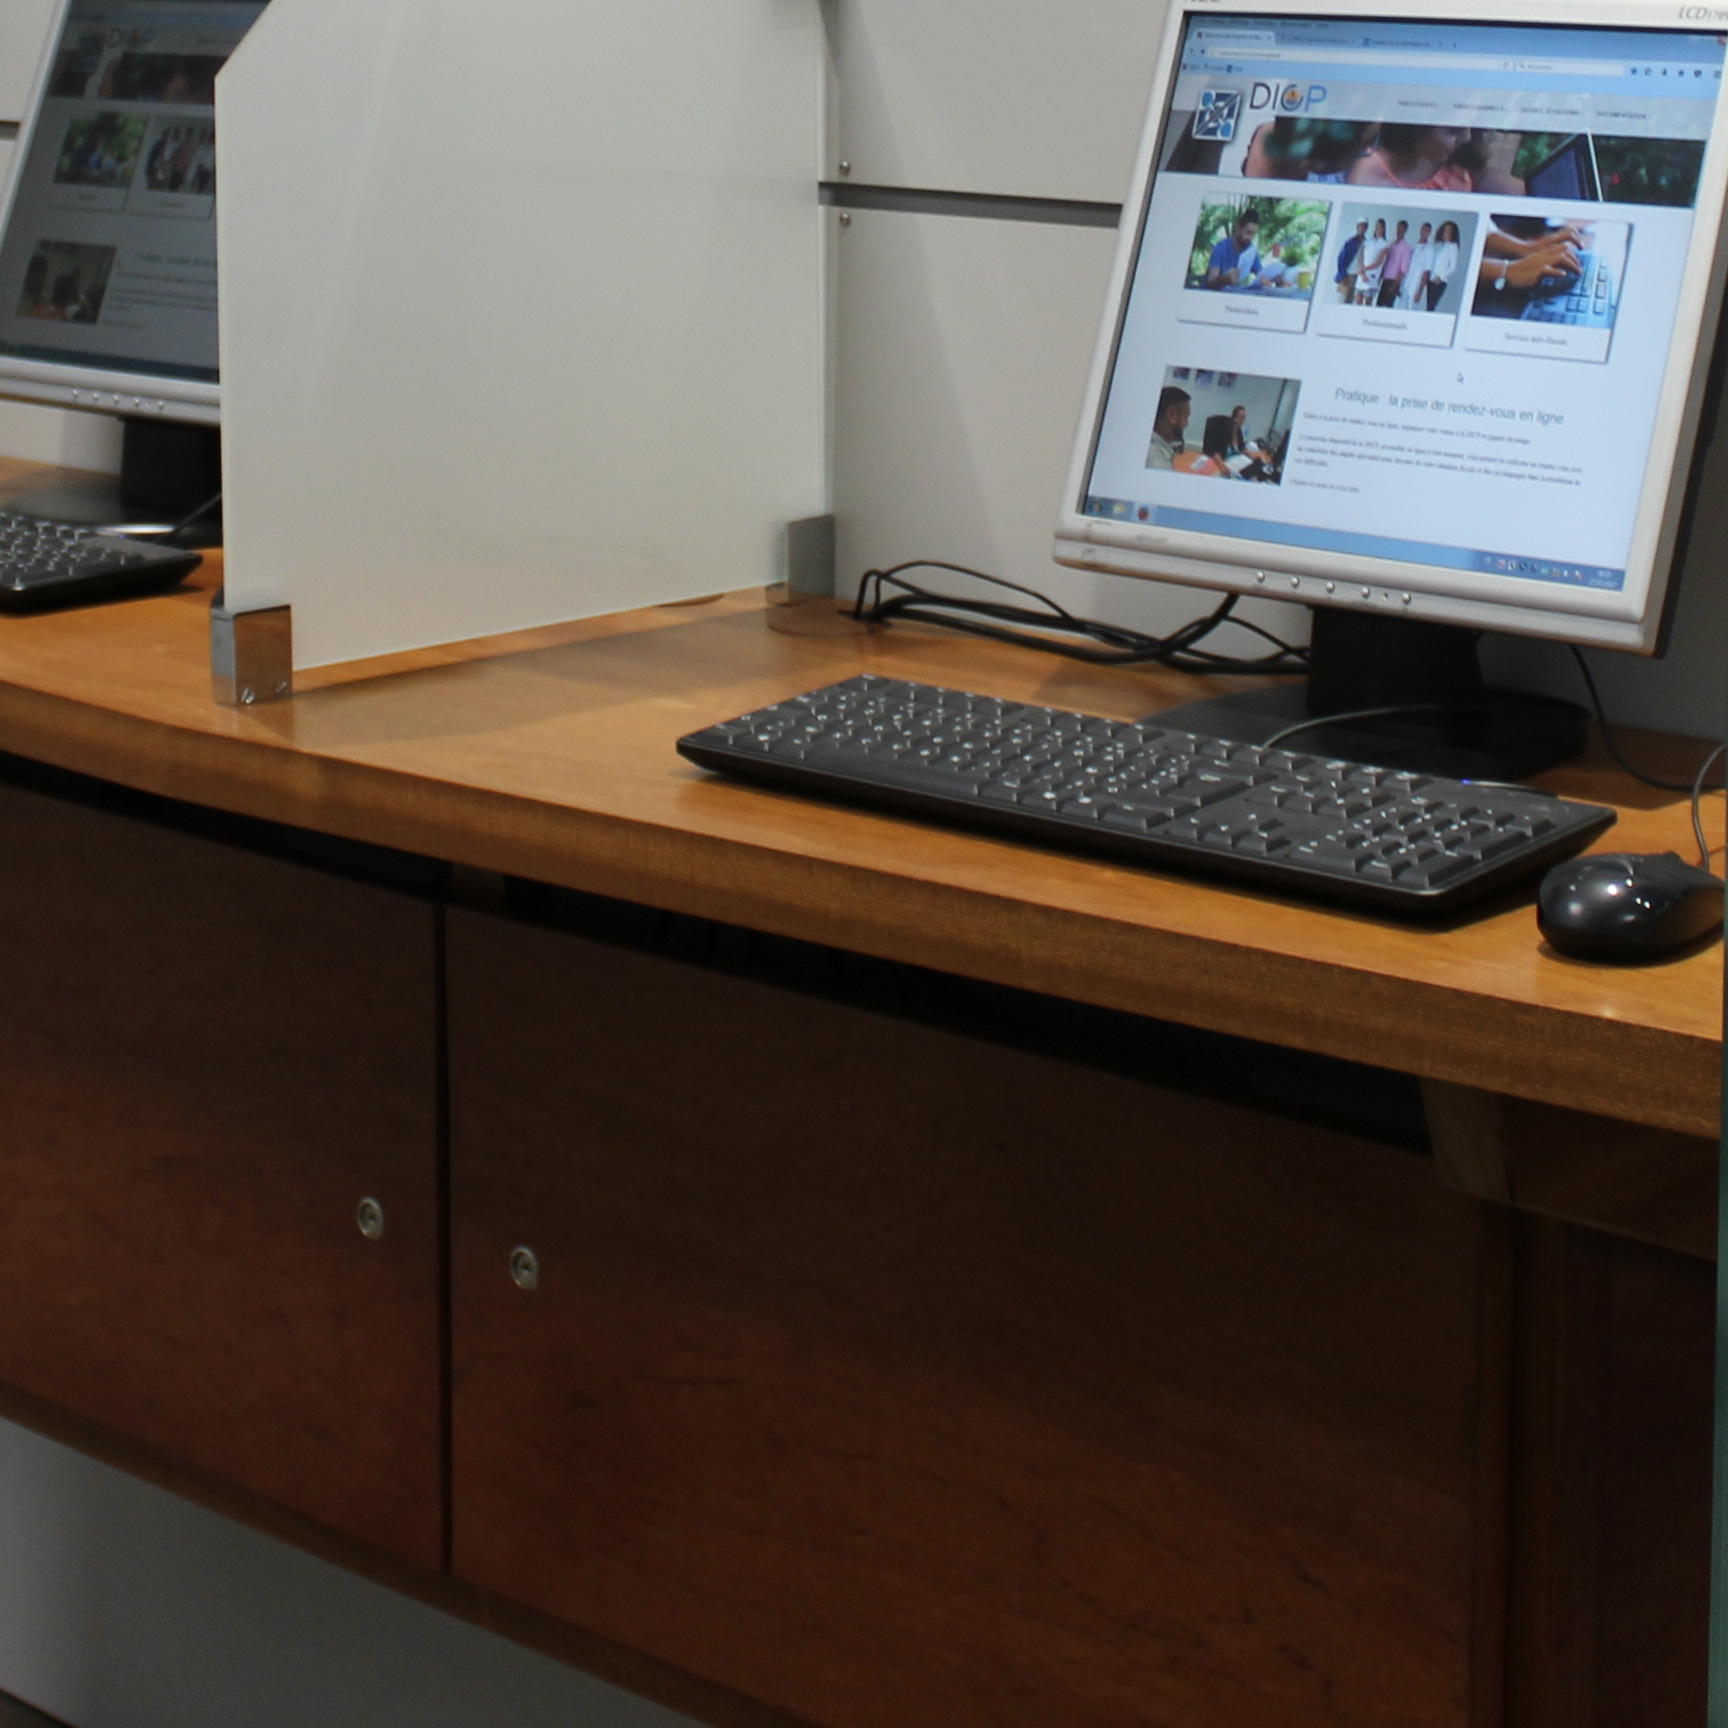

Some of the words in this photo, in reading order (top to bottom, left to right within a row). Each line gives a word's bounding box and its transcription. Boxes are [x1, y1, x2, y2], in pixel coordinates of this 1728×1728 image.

[1334, 387, 1380, 406] Pratique
[1388, 393, 1399, 405] la
[1401, 396, 1428, 410] prise
[1430, 399, 1446, 412] de
[1447, 401, 1517, 421] rendez-vous
[1519, 410, 1534, 422] en
[1536, 410, 1565, 426] ligne
